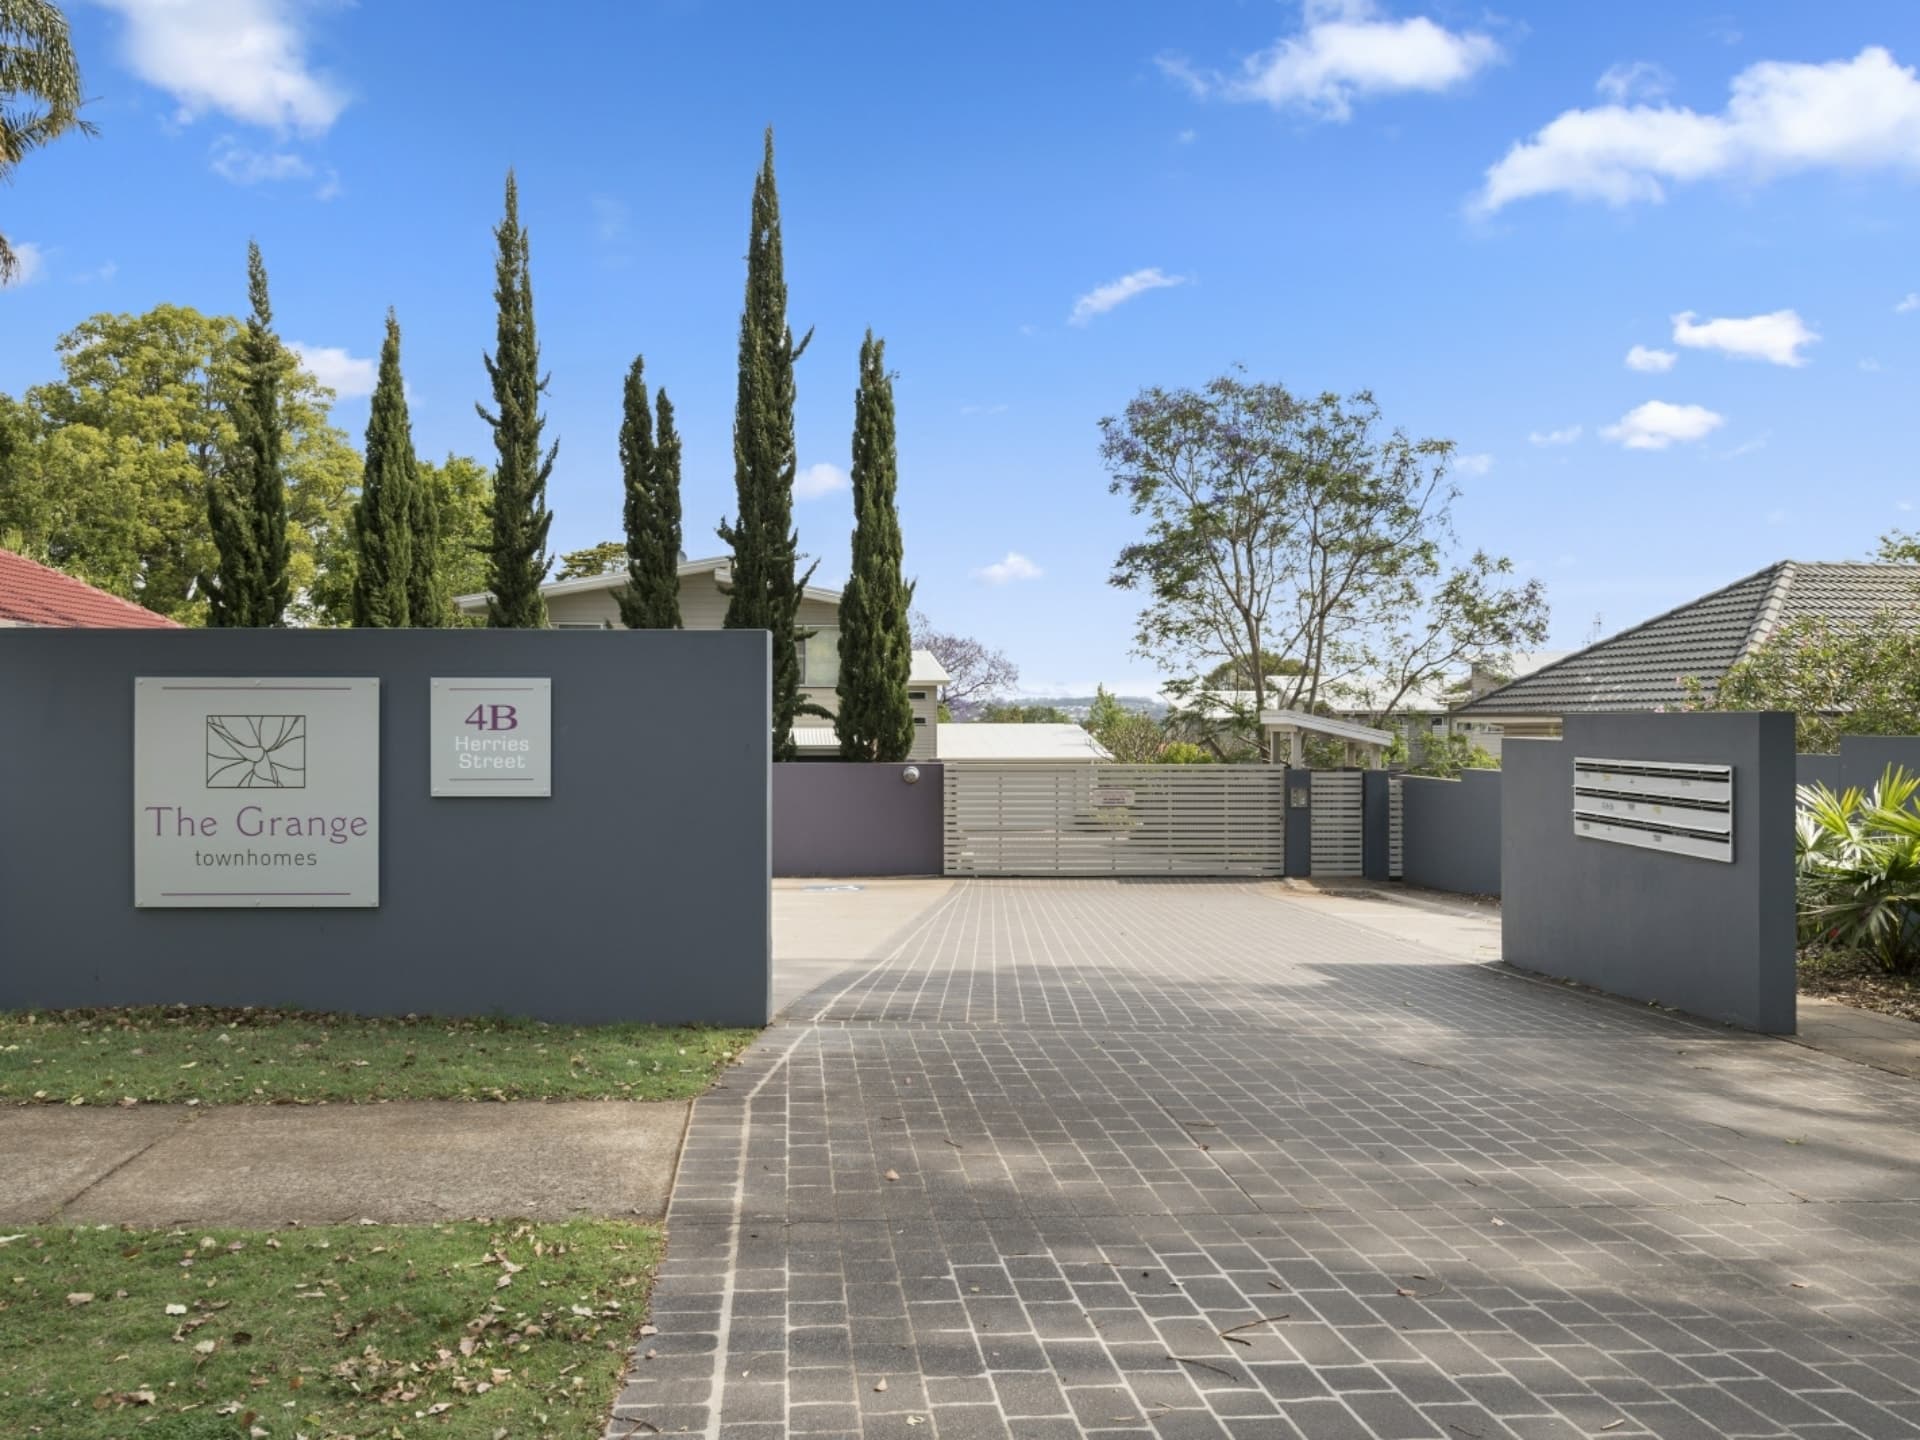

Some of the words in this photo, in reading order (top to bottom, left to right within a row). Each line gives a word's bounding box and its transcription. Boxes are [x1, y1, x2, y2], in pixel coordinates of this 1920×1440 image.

[464, 704, 518, 731] 4B
[455, 735, 530, 752] Herries
[458, 753, 526, 769] Street
[145, 806, 217, 837] The
[236, 806, 368, 844] Grange
[195, 849, 317, 866] townhomes
